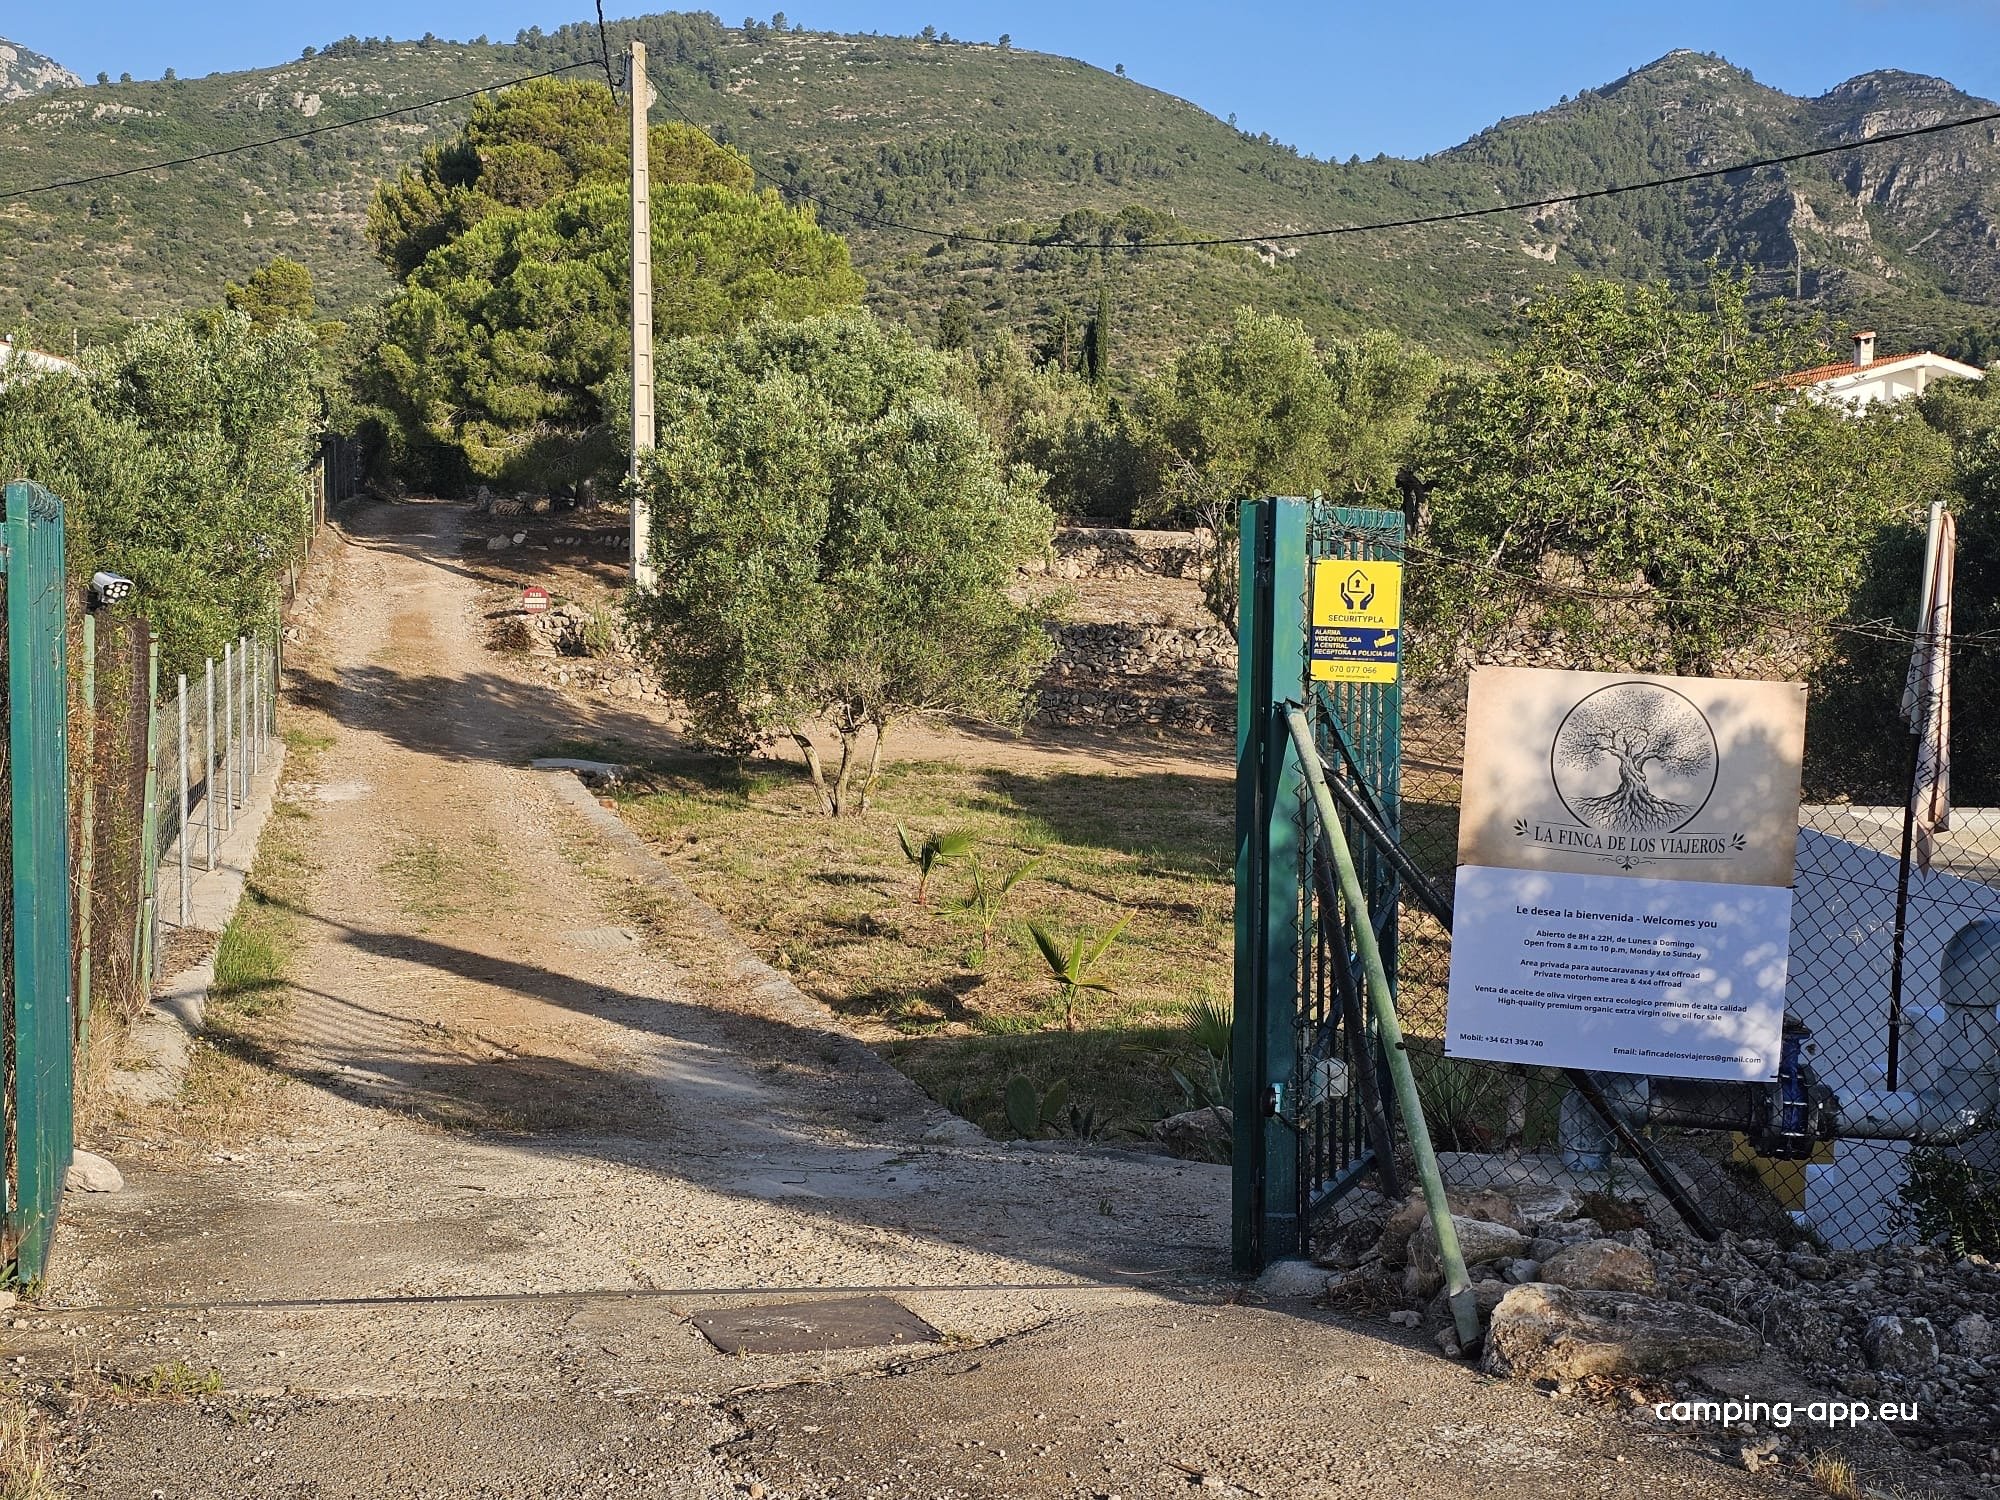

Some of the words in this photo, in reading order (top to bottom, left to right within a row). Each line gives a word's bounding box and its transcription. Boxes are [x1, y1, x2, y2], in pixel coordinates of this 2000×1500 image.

[1328, 615, 1384, 623] SECURITYPLA
[1534, 826, 1553, 843] LA
[1559, 830, 1602, 849] FINCA
[1608, 836, 1625, 850] DE
[1630, 837, 1655, 853] LOS
[1660, 838, 1725, 854] VIAJEROS
[1516, 906, 1528, 915] Le
[1531, 906, 1561, 917] desea
[1564, 909, 1573, 918] la
[1576, 910, 1634, 923] bienvenida
[1643, 915, 1696, 927] Welcomes
[1698, 920, 1718, 929] you
[1524, 939, 1544, 948] Open
[1546, 940, 1565, 949] from
[1610, 946, 1628, 955] p.m,
[1630, 947, 1660, 957] Monday
[1662, 949, 1671, 957] to
[1672, 950, 1702, 959] Sunday
[1536, 930, 1565, 939] Abierto
[1567, 931, 1577, 940] de
[1598, 934, 1615, 943] 22H,
[1628, 936, 1651, 945] Lunes
[1659, 939, 1695, 949] Domingo
[1520, 959, 1538, 967] Area
[1540, 961, 1570, 970] privada
[1591, 965, 1648, 976] autocaravanas
[1656, 969, 1670, 977] 4x4
[1671, 970, 1700, 979] offroad
[1533, 970, 1562, 979] Private
[1563, 973, 1609, 983] motorhome
[1653, 979, 1682, 988] offroad
[1474, 985, 1497, 993] Venta
[1510, 988, 1534, 996] aceite
[1547, 991, 1565, 999] oliva
[1567, 993, 1591, 1002] virgen
[1616, 997, 1652, 1006] ecologico
[1654, 1000, 1689, 1009] premium
[1692, 1002, 1701, 1010] de
[1703, 1003, 1717, 1011] alta
[1720, 1004, 1747, 1012] calidad
[1498, 997, 1545, 1008] High-quality
[1547, 1001, 1582, 1010] premium
[1584, 1005, 1613, 1014] organic
[1638, 1009, 1660, 1017] virgin
[1460, 1033, 1483, 1041] Mobil:
[1613, 1047, 1637, 1056] Email:
[1638, 1049, 1761, 1063] lafincadelosviajeros@gmail.com
